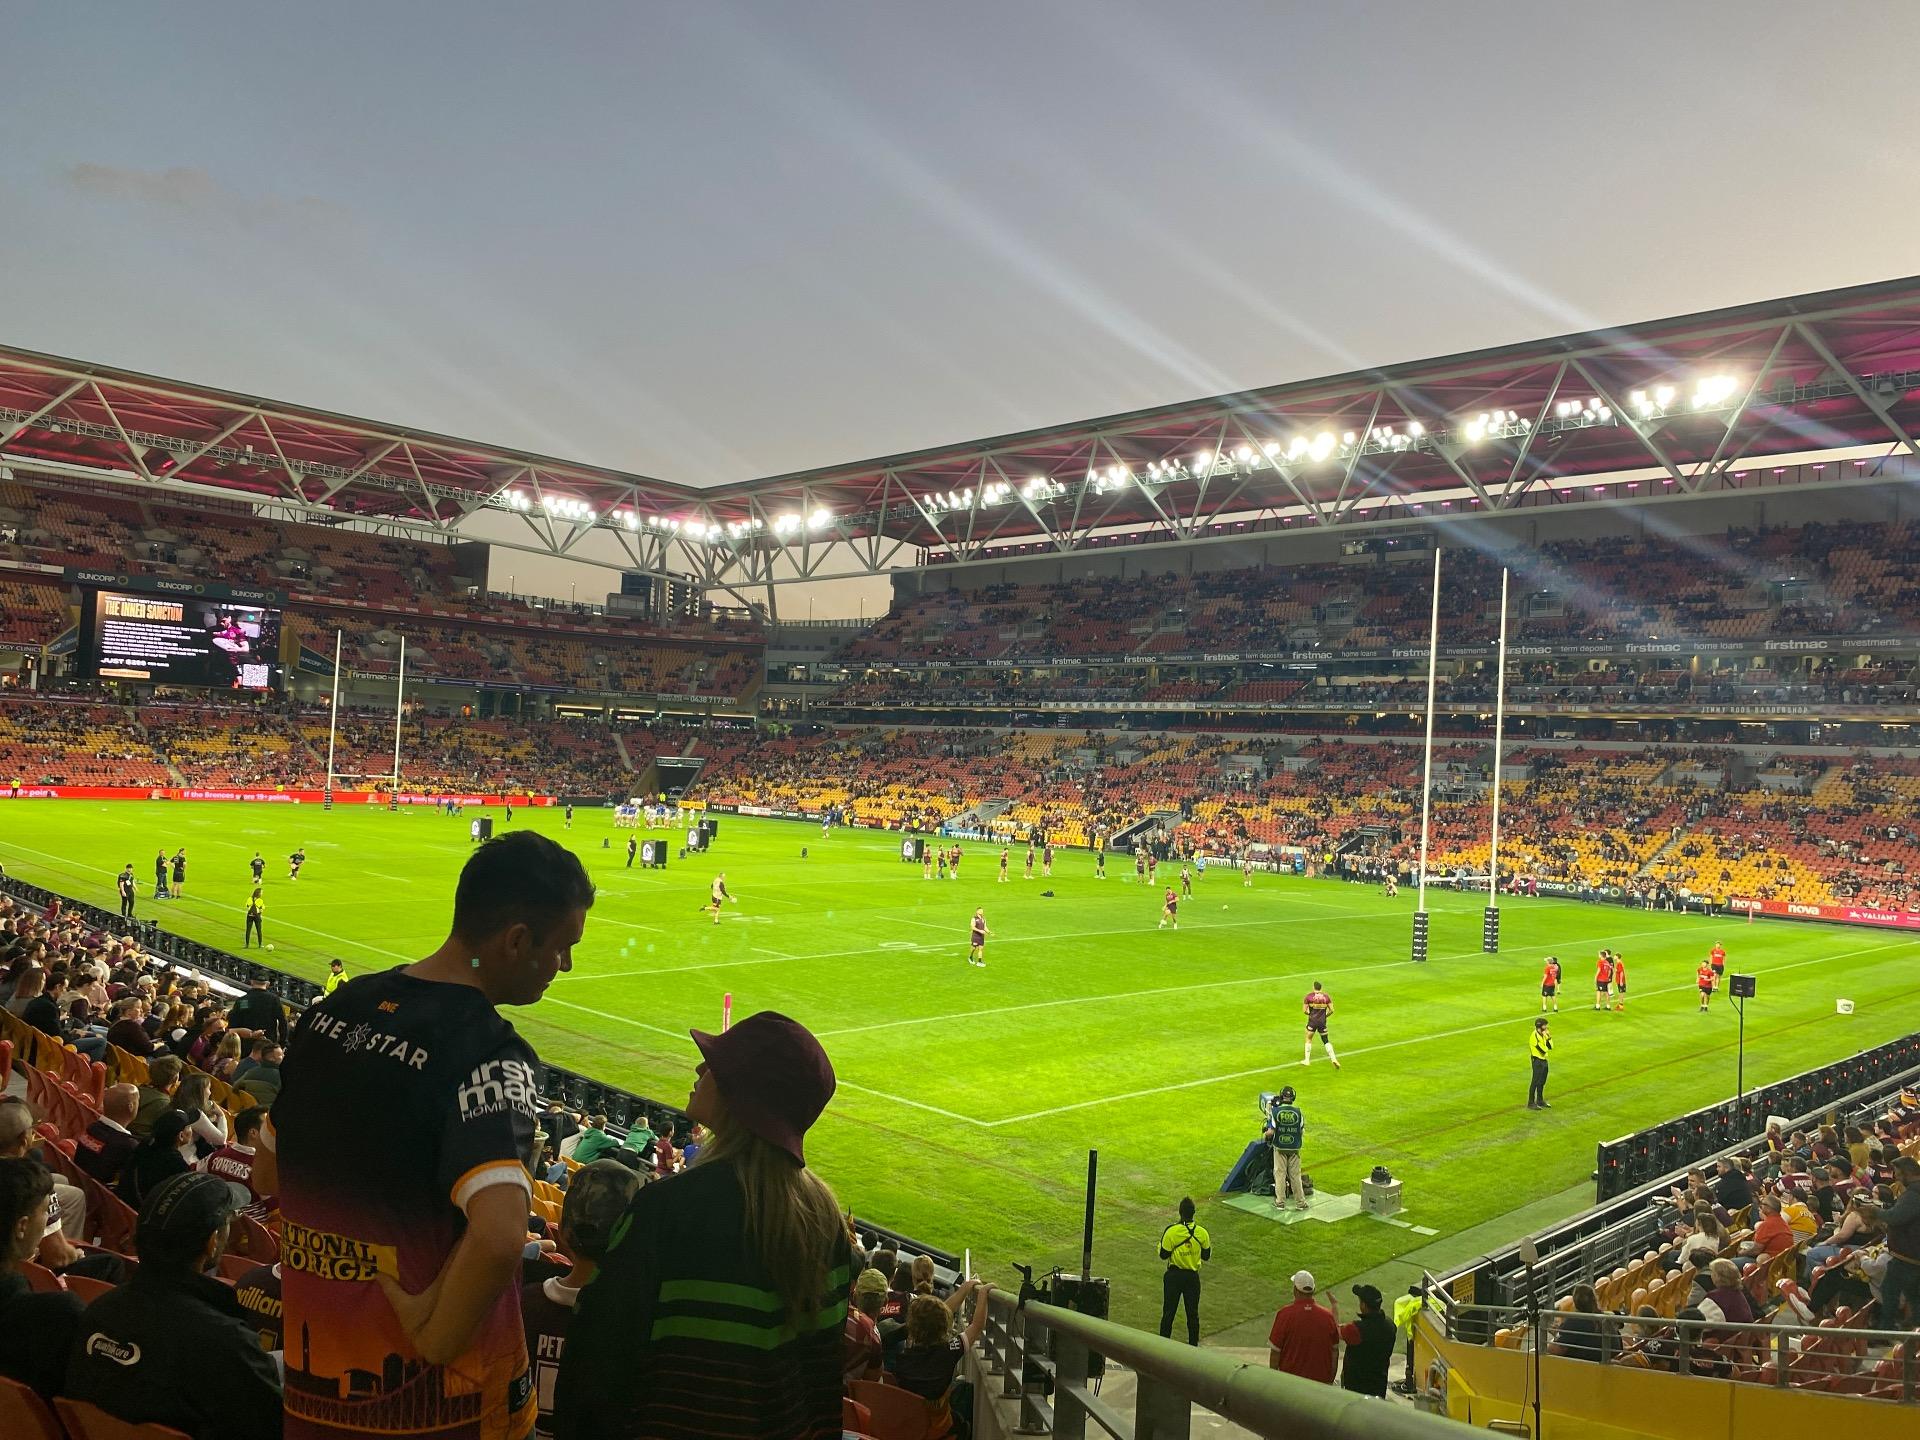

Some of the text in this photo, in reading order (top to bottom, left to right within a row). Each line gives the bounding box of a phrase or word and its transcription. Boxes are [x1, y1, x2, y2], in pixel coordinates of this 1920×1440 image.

[78, 572, 115, 582] SUNCORP
[156, 581, 192, 591] SUNCORP
[231, 589, 264, 599] SUNCORP
[105, 600, 183, 621] THE INNER SANCTUM
[16, 645, 42, 653] CLINICS
[1626, 642, 1744, 653] firstmac home loans
[1765, 638, 1901, 650] firstmac investments
[1392, 647, 1487, 658] firstma investments
[1505, 645, 1552, 655] irstmac
[1580, 645, 1613, 654] deposits
[1124, 654, 1156, 663] firstmac
[1204, 653, 1240, 661] firstmac
[1292, 651, 1333, 660] firstmac
[352, 671, 388, 681] firstmac
[1701, 706, 1726, 714] JIMMY
[1755, 706, 1808, 714] BARBERSHOP
[191, 791, 203, 799] the
[204, 792, 235, 800] Broncos
[1536, 881, 1566, 891] SUNCORP
[1731, 900, 1762, 910] nova
[1788, 904, 1820, 915] nova
[1862, 912, 1898, 922] VALIANT
[378, 1000, 400, 1014] BNE
[309, 1012, 429, 1071] THE STAR
[461, 1101, 508, 1123] HOME
[1280, 1112, 1296, 1120] FOX
[536, 1333, 565, 1360] PET
